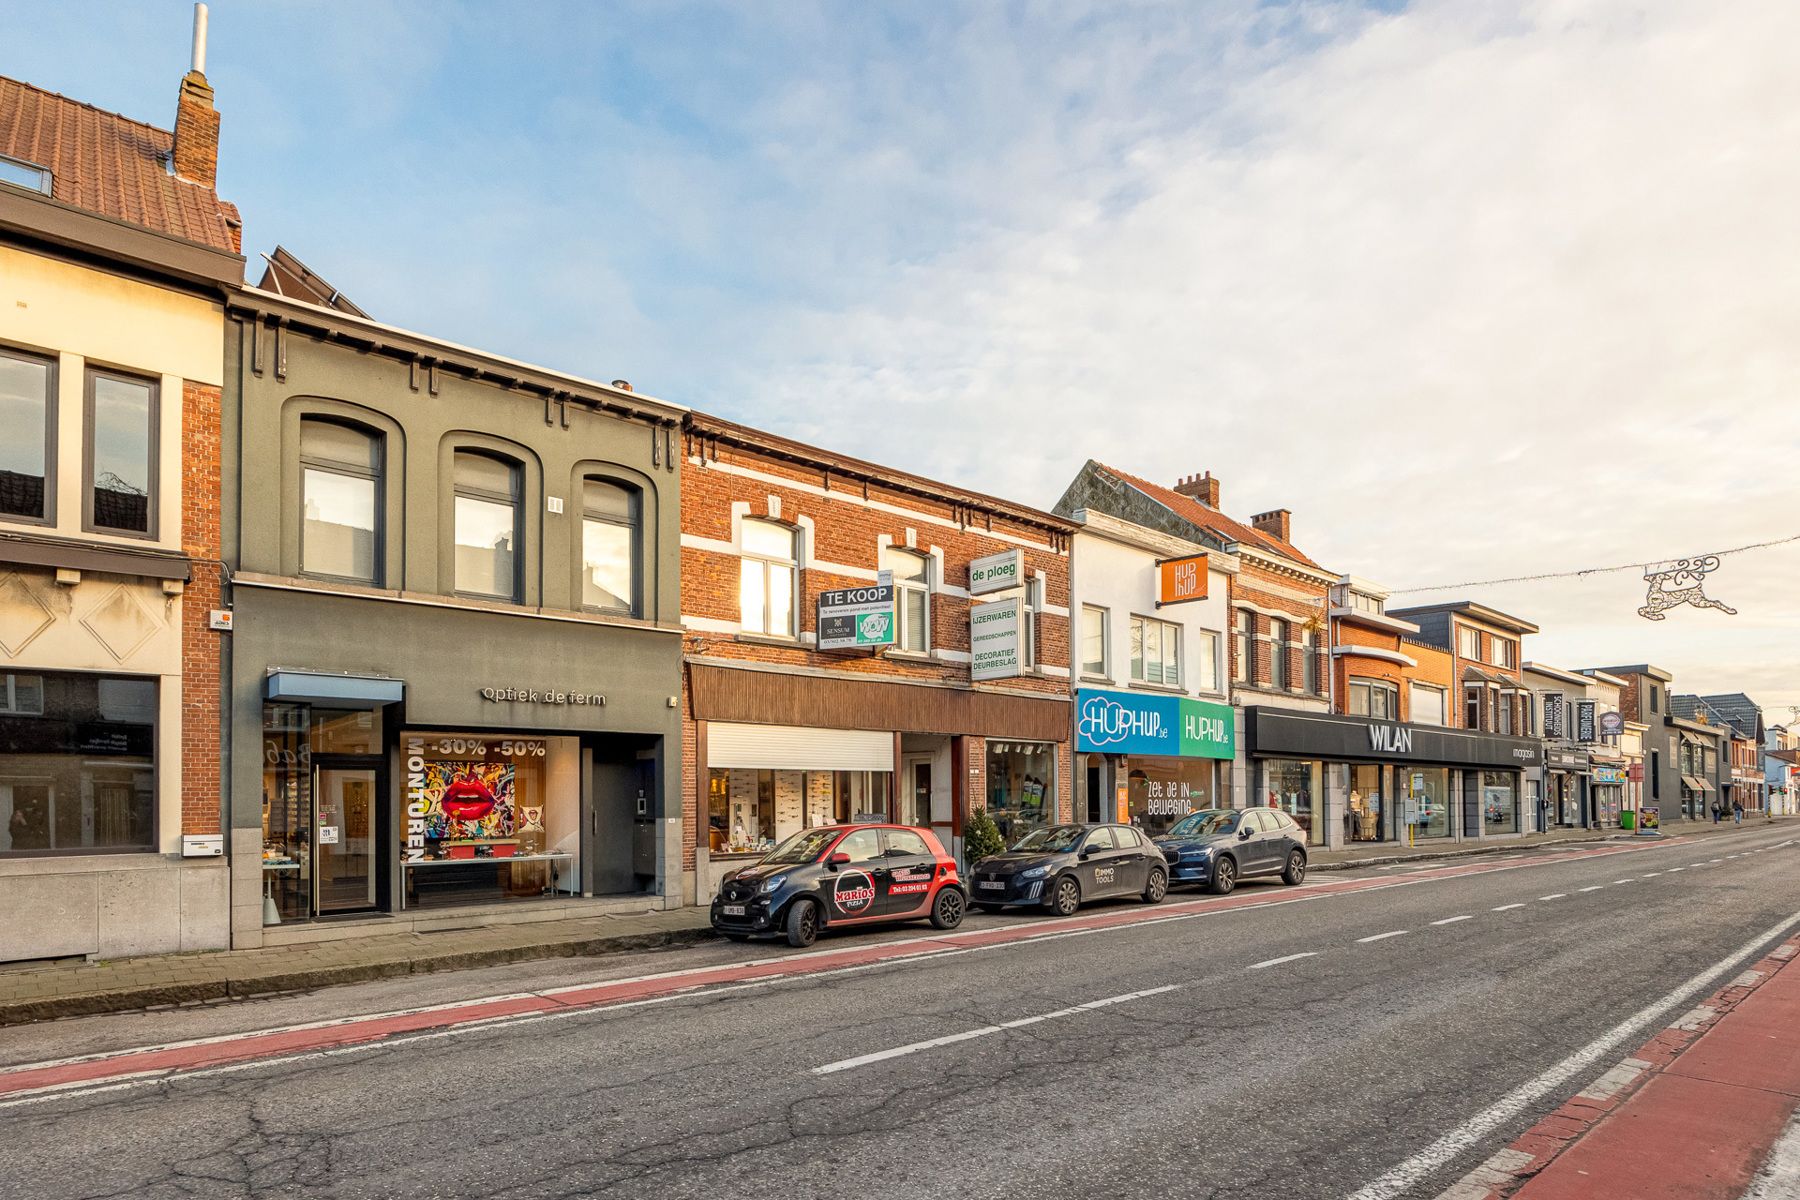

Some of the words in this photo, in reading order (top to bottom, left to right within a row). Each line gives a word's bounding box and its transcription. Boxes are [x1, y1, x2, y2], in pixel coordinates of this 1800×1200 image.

[972, 570, 984, 581] de
[987, 563, 1016, 580] ploeg
[826, 592, 843, 605] TE
[847, 588, 887, 603] KOOP
[972, 610, 1016, 625] IJZERWAREN
[972, 630, 1016, 642] GEREEDSCHAPPEN
[975, 648, 1015, 661] DECORATIEF
[973, 657, 1016, 670] DEURBESLAG
[545, 689, 565, 703] de
[570, 690, 606, 704] ferm
[1553, 696, 1561, 736] SCHOONHEIDS
[1369, 724, 1412, 752] WILAN
[431, 739, 487, 755] -30%
[494, 741, 546, 756] -50%
[408, 738, 424, 864] MONTUREN
[1096, 875, 1114, 884] TOOLS
